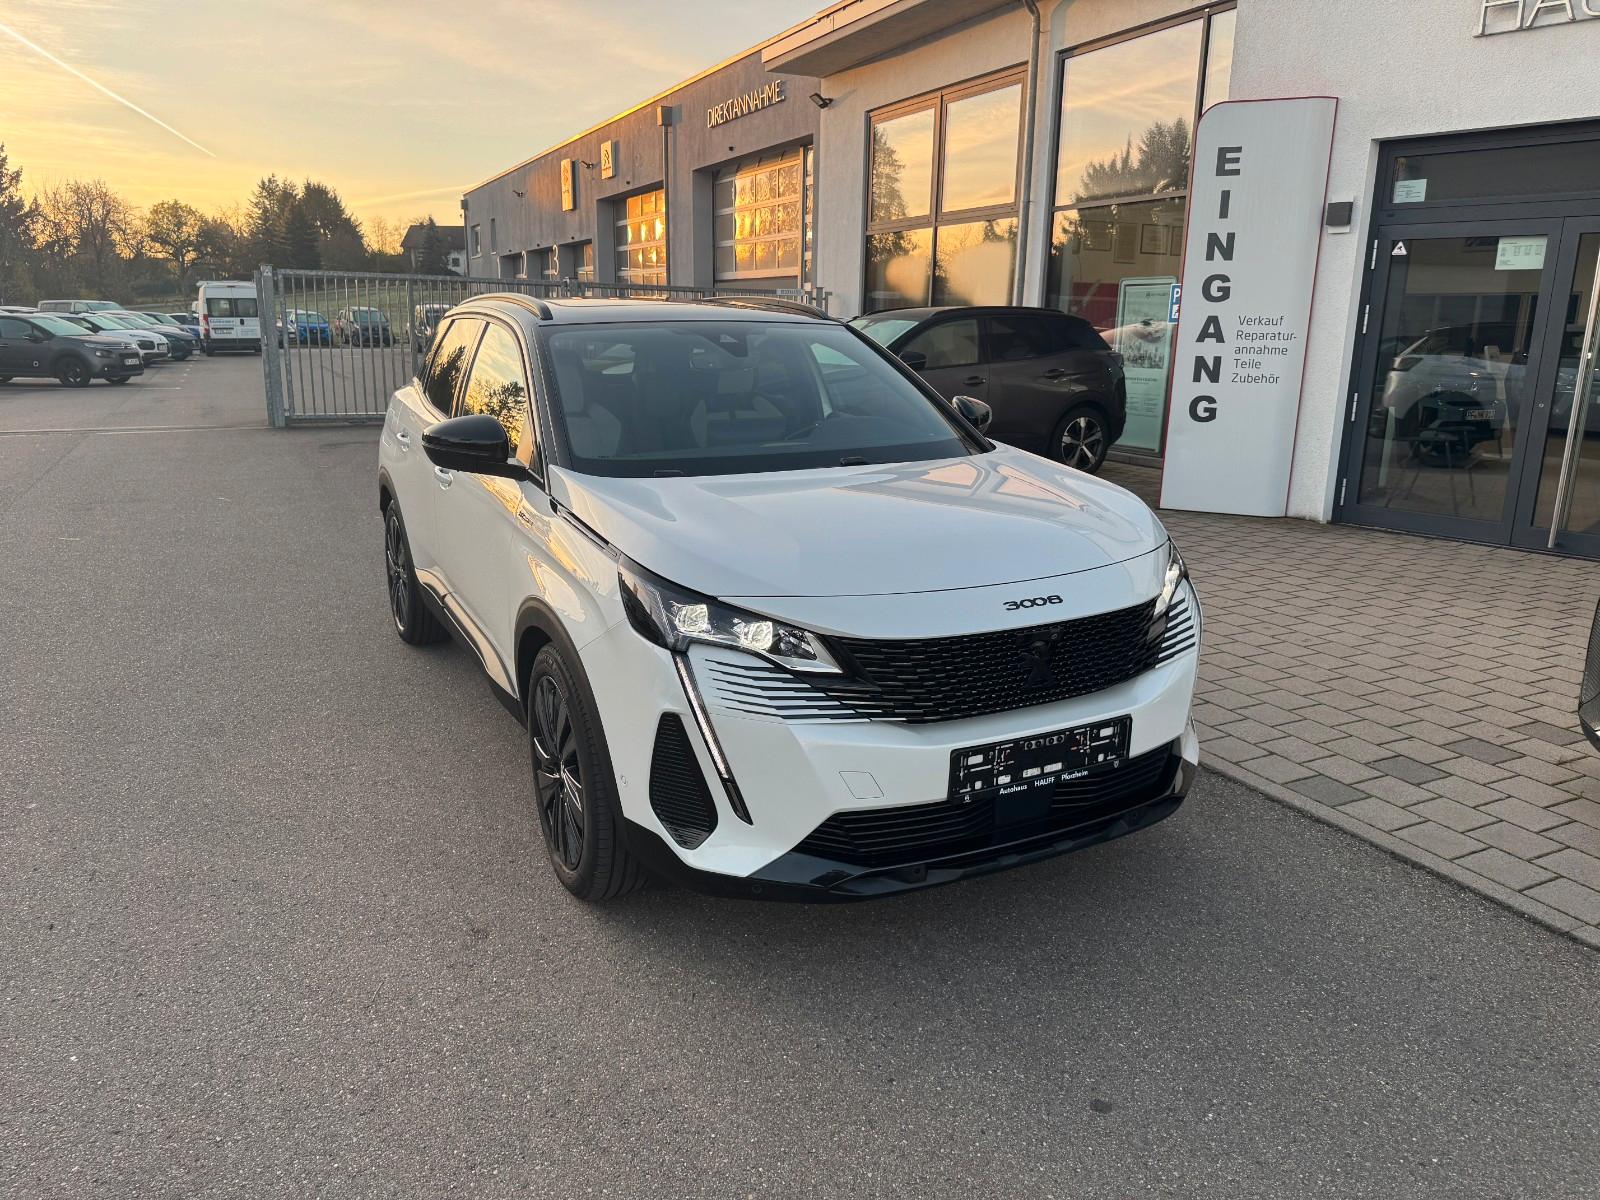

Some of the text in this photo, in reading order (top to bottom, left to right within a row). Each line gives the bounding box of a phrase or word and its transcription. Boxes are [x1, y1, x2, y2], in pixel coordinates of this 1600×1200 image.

[1479, 0, 1600, 36] HA
[707, 80, 782, 128] DIREKTANNAHME
[1188, 146, 1243, 423] EINGANG
[1238, 315, 1284, 326] Verkauf
[1236, 330, 1297, 343] Reparatur-
[1234, 345, 1288, 356] annahme
[1233, 358, 1262, 369] Teile
[1231, 373, 1280, 385] Zubehör
[1003, 595, 1064, 611] 3008
[999, 784, 1028, 795] Autohaus
[1034, 776, 1055, 787] HAUFF
